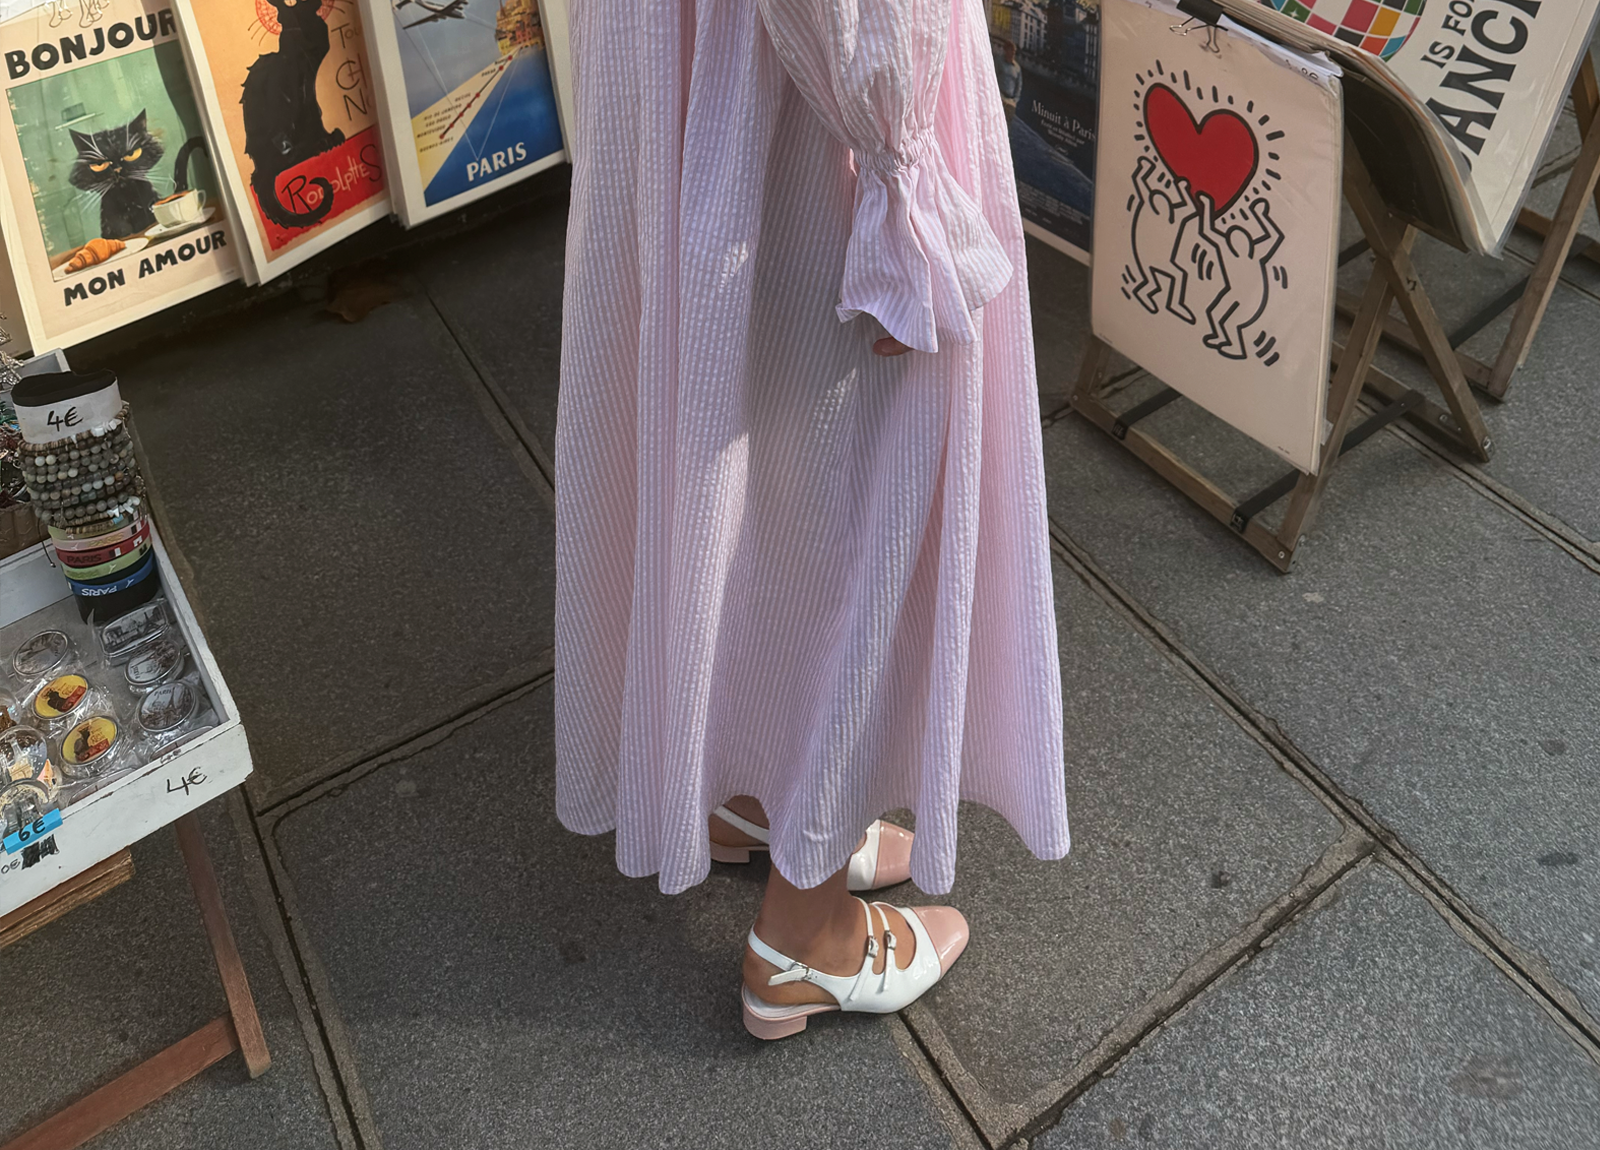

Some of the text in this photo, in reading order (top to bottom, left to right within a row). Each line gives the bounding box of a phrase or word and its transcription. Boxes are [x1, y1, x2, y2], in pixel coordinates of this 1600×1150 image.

[4, 7, 178, 81] BONJOUR
[1420, 40, 1456, 69] IS
[1031, 99, 1097, 143] Minuit à Paris
[466, 141, 528, 183] PARIS
[63, 230, 228, 307] MON AMOUR
[47, 406, 84, 432] 4€
[66, 553, 103, 565] PARIS
[81, 584, 118, 597] PARIS
[166, 766, 208, 796] 4€
[18, 816, 46, 842] 6€
